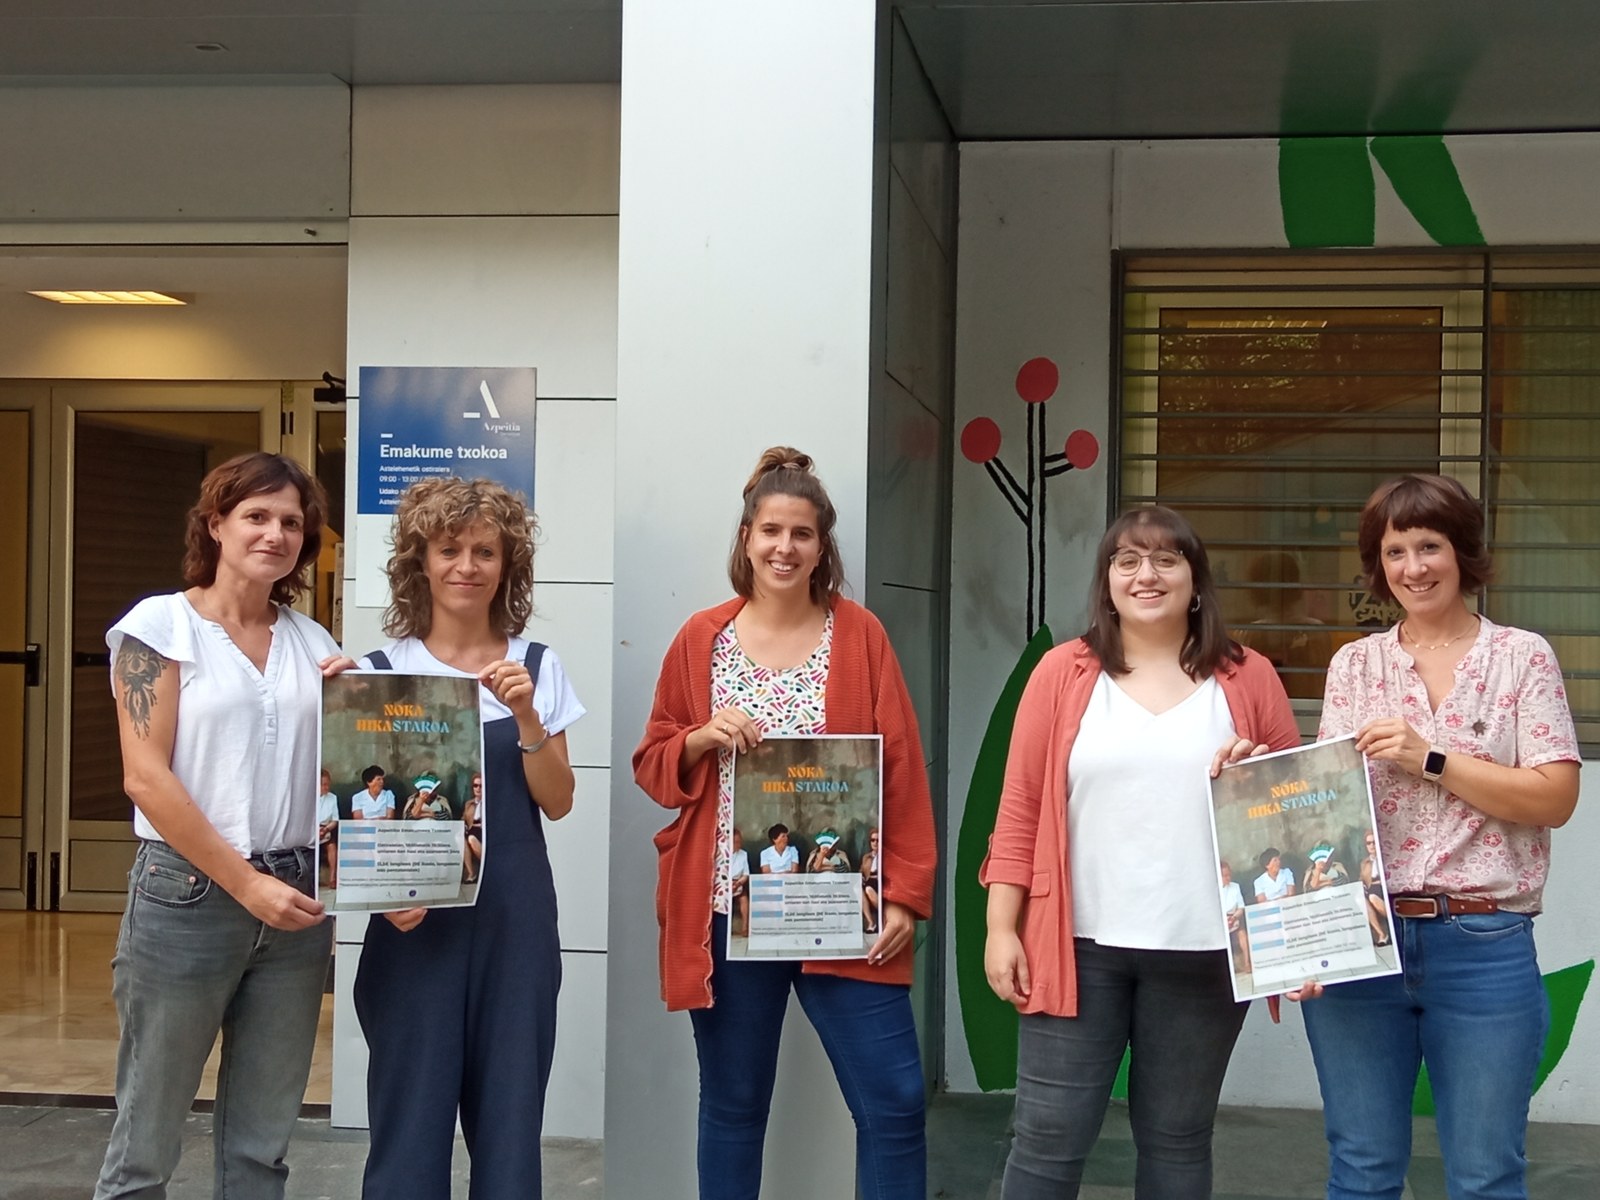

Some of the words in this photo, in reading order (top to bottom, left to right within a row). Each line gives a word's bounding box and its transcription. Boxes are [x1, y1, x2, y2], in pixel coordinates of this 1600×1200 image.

[484, 422, 521, 433] Azpeitia
[380, 444, 454, 459] Emakume
[457, 445, 508, 459] txokoa
[384, 703, 424, 717] NOKA
[356, 719, 450, 734] HIKASTAROA
[787, 766, 826, 779] NOKA
[762, 781, 849, 793] HIKASTAROA
[1270, 780, 1310, 798] NOKA
